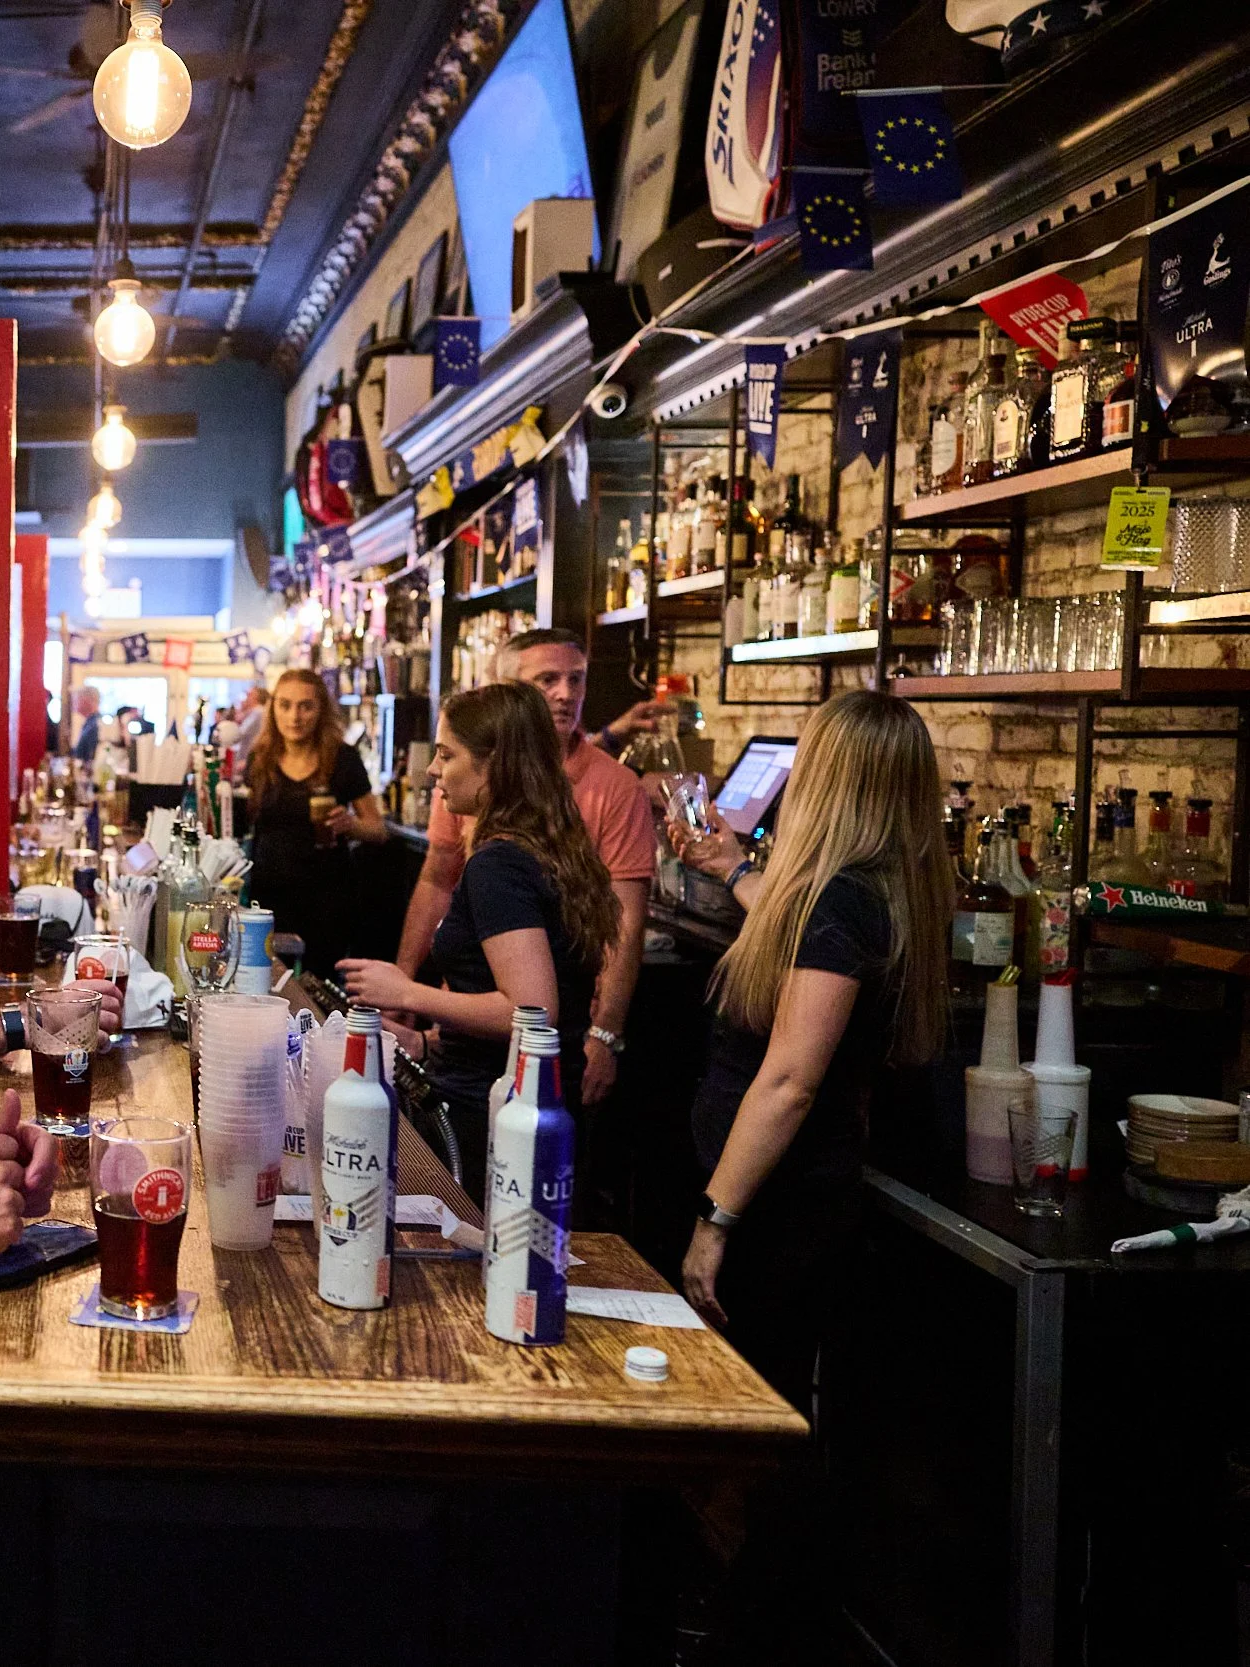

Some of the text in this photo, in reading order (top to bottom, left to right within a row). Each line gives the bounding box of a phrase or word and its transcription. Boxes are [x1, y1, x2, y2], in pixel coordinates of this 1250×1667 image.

[817, 53, 868, 72] Bank
[713, 0, 748, 188] SRIXO
[1009, 303, 1046, 328] RYDER
[1043, 293, 1071, 315] CUP
[1176, 317, 1213, 344] ULTRA
[1120, 505, 1155, 517] 2025
[1130, 889, 1208, 912] Heineken
[193, 935, 218, 943] STELLA
[293, 1126, 305, 1135] CUP
[283, 1133, 305, 1154] IVE
[322, 1149, 381, 1171] LTRA
